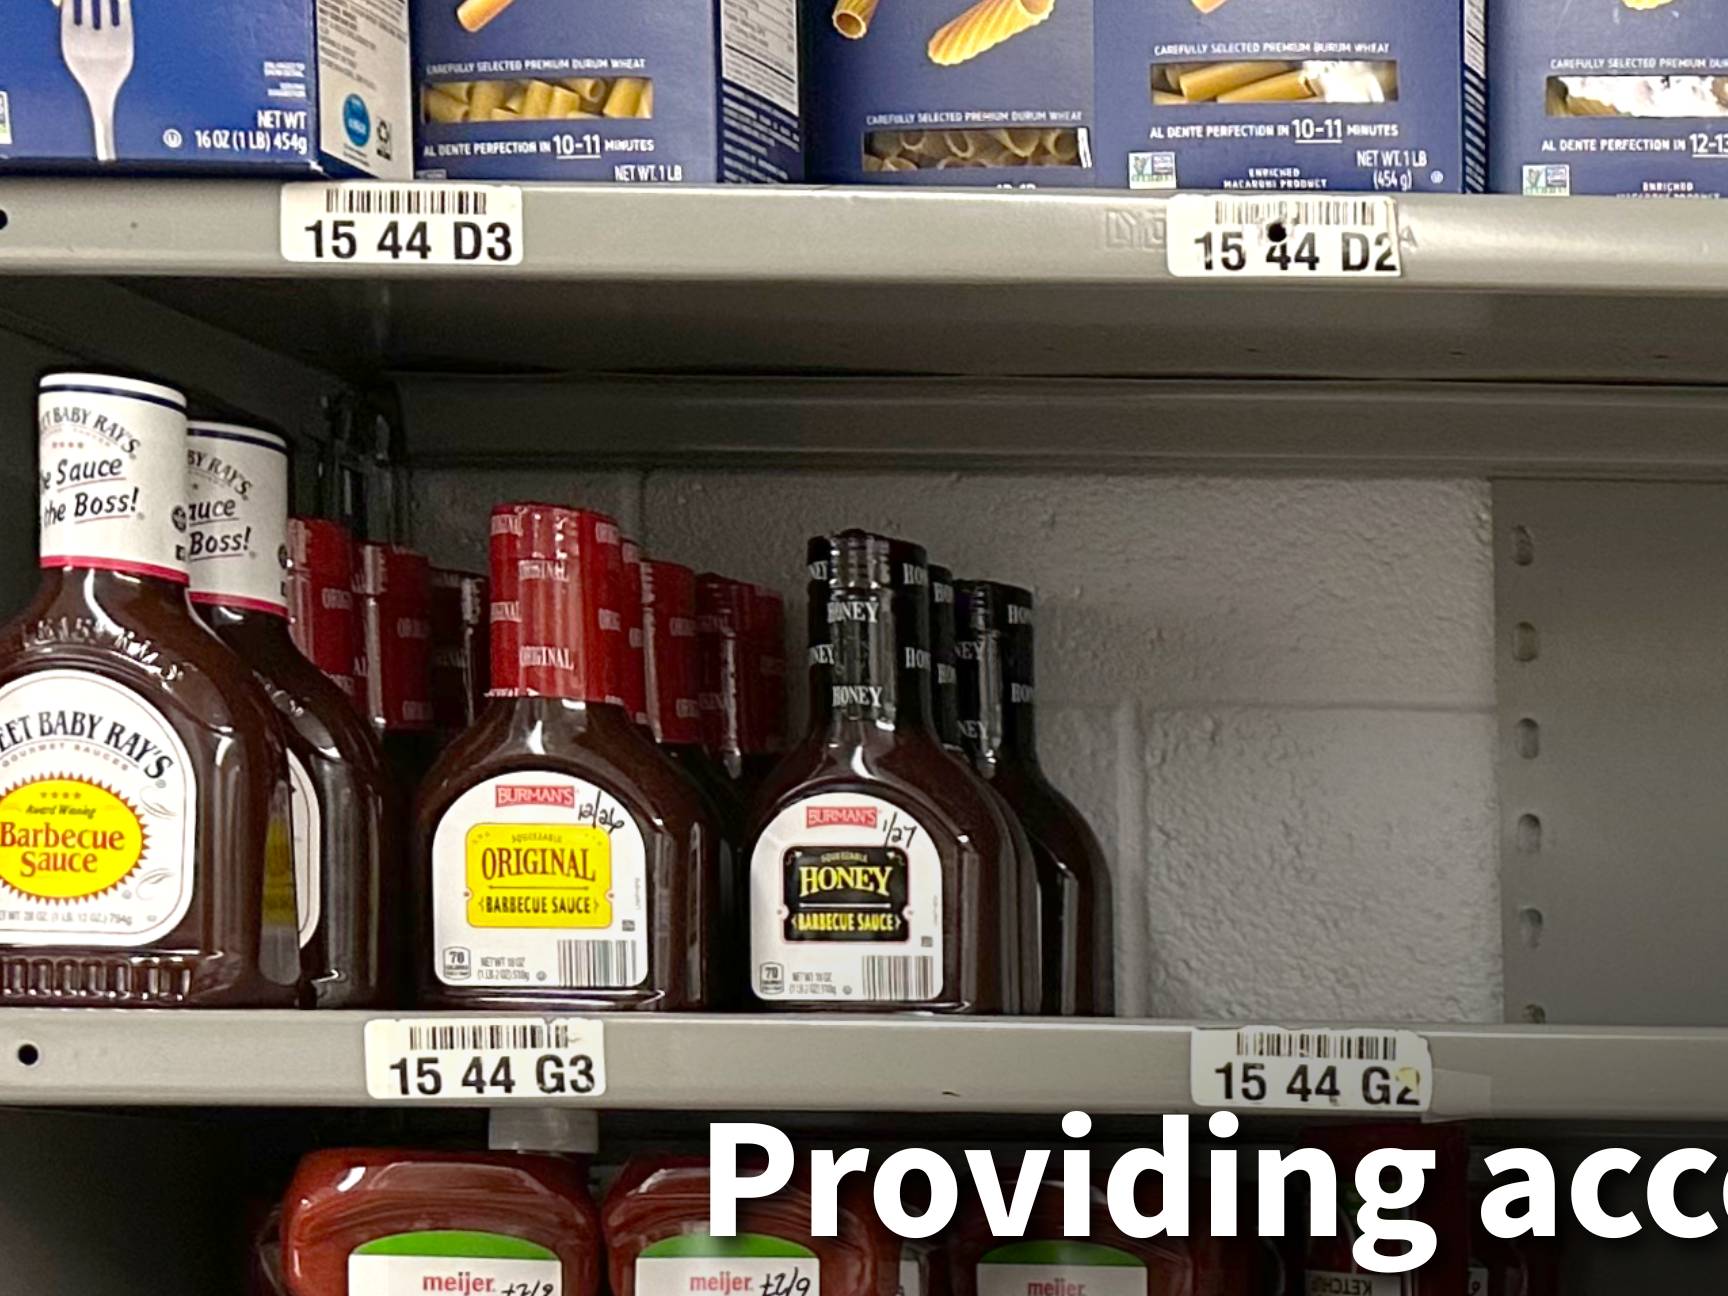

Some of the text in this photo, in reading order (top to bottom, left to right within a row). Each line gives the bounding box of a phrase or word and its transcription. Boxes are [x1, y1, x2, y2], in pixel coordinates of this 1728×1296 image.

[195, 131, 211, 148] 16
[212, 131, 230, 148] OZ
[274, 133, 307, 155] 454g
[1150, 127, 1166, 139] AL
[1168, 126, 1206, 139] DENTE
[1292, 119, 1344, 143] 10-11
[1346, 123, 1399, 138] MINUTES
[304, 220, 513, 262] 15 44 D3
[1195, 232, 1398, 274] 15 44 D2
[73, 488, 140, 518] Boss!
[37, 712, 174, 781] BABY RAY'S
[497, 787, 574, 806] BURMAN'S
[0, 821, 125, 851] Barbecue
[19, 851, 98, 876] Sauce
[481, 846, 596, 882] ORIGINAL
[799, 864, 894, 897] HONEY
[485, 896, 591, 915] BARBECUE SAUCE
[797, 911, 895, 931] BARBECUE SAUCE
[389, 1055, 596, 1094] 15 44 G3
[1214, 1061, 1421, 1106] 15 44 G2
[422, 1271, 495, 1296] meijer
